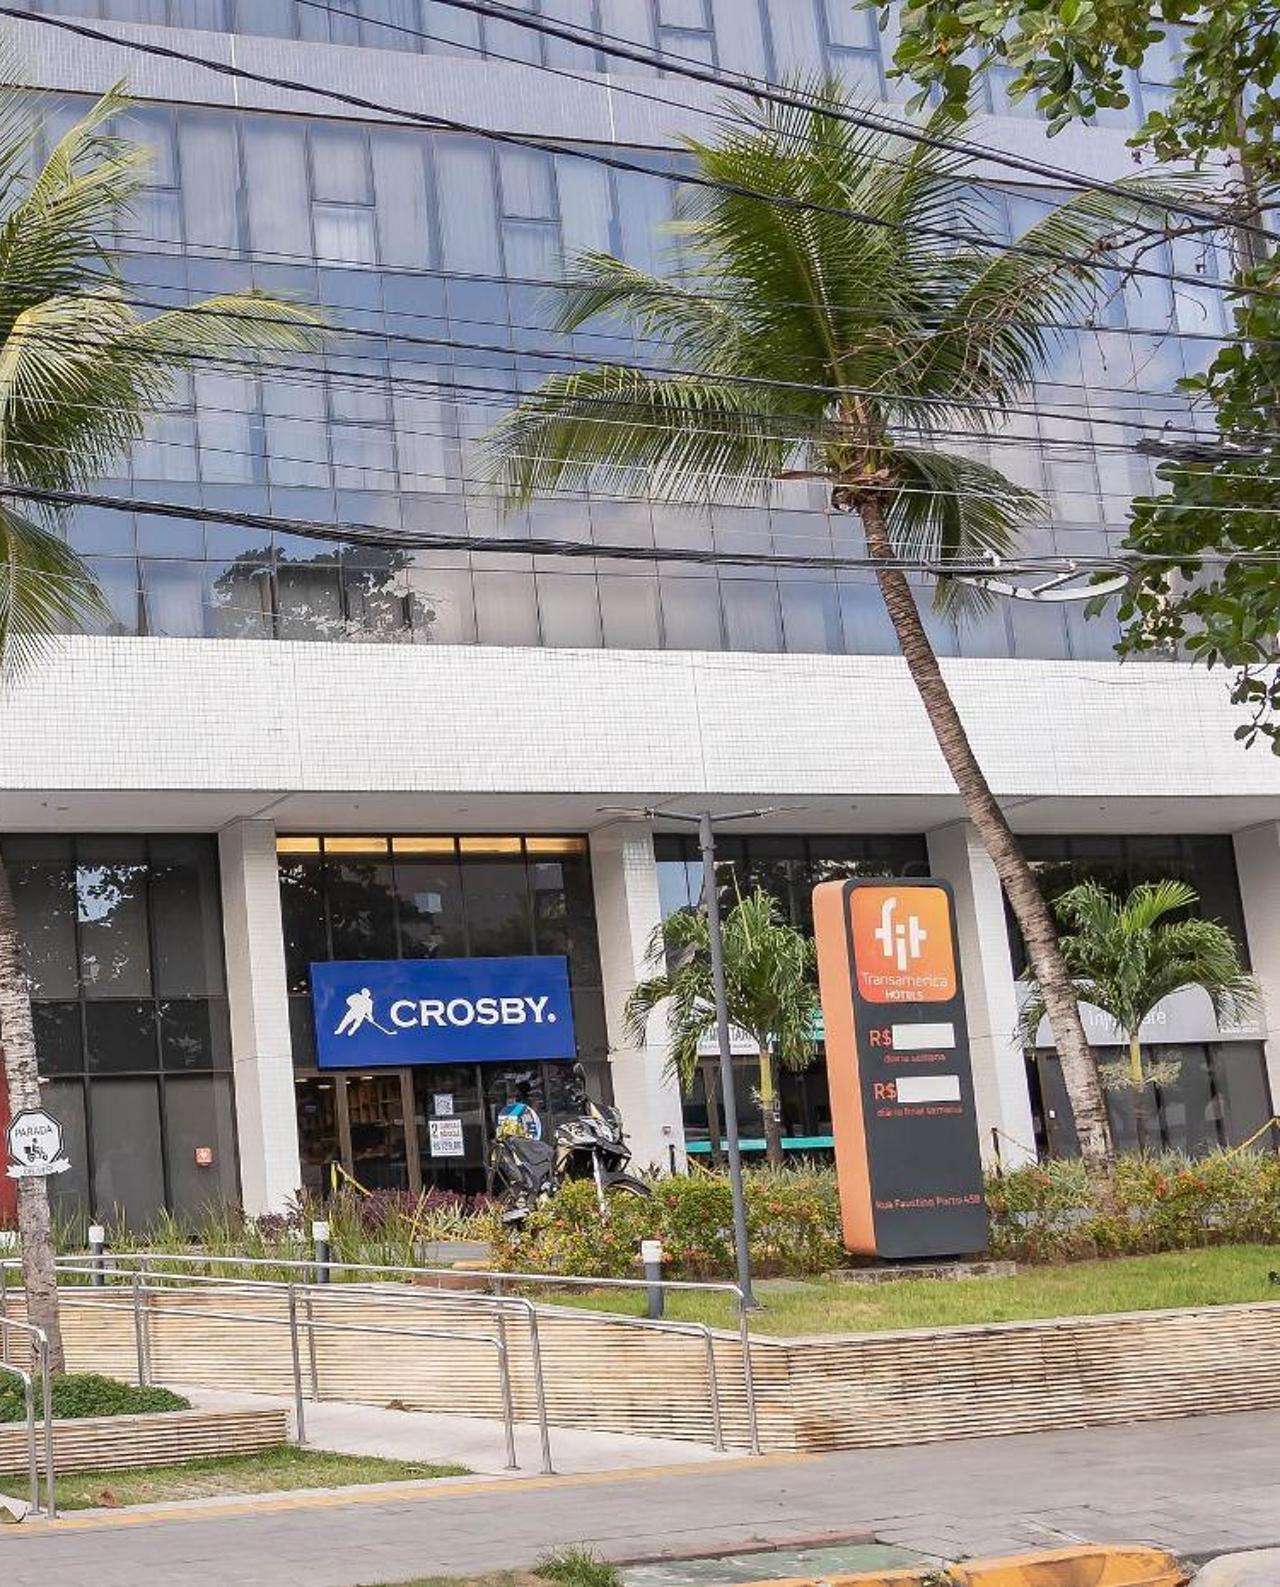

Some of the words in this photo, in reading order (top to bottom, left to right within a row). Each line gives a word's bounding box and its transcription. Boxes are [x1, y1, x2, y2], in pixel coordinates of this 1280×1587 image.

[875, 896, 927, 971] fit
[885, 988, 924, 1000] HOTELS
[869, 1028, 892, 1048] R$
[873, 1082, 897, 1102] R$
[15, 1125, 53, 1138] PARADA
